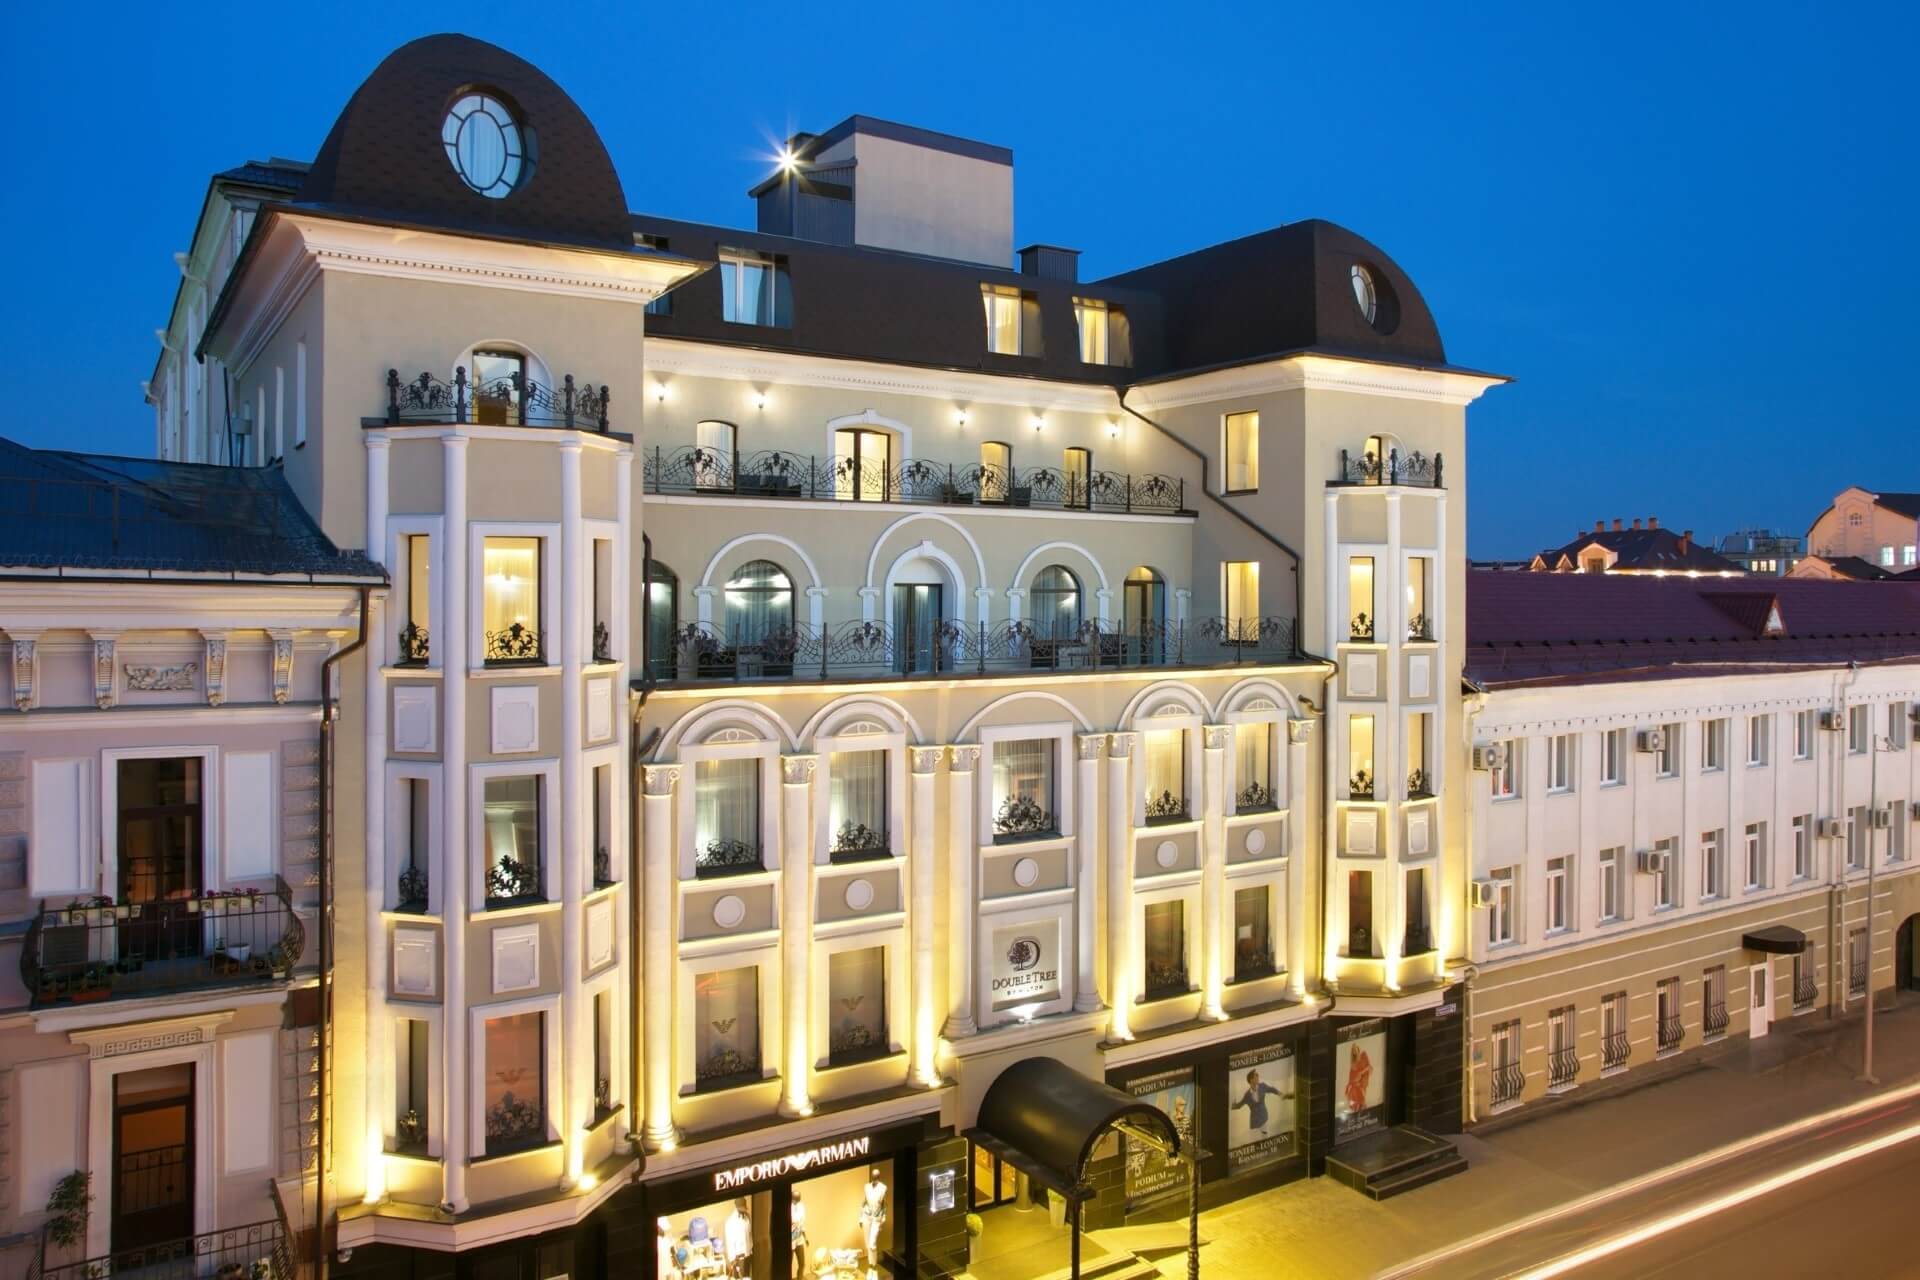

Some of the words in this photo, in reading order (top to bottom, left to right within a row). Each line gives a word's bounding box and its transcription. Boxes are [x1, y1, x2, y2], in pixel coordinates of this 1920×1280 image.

[992, 970, 1057, 991] DOUBLETREE
[1134, 1079, 1166, 1096] PODIUM
[715, 1156, 790, 1191] EMPORIO
[810, 1137, 870, 1168] ARMANI
[1135, 1170, 1167, 1188] PODIUM
